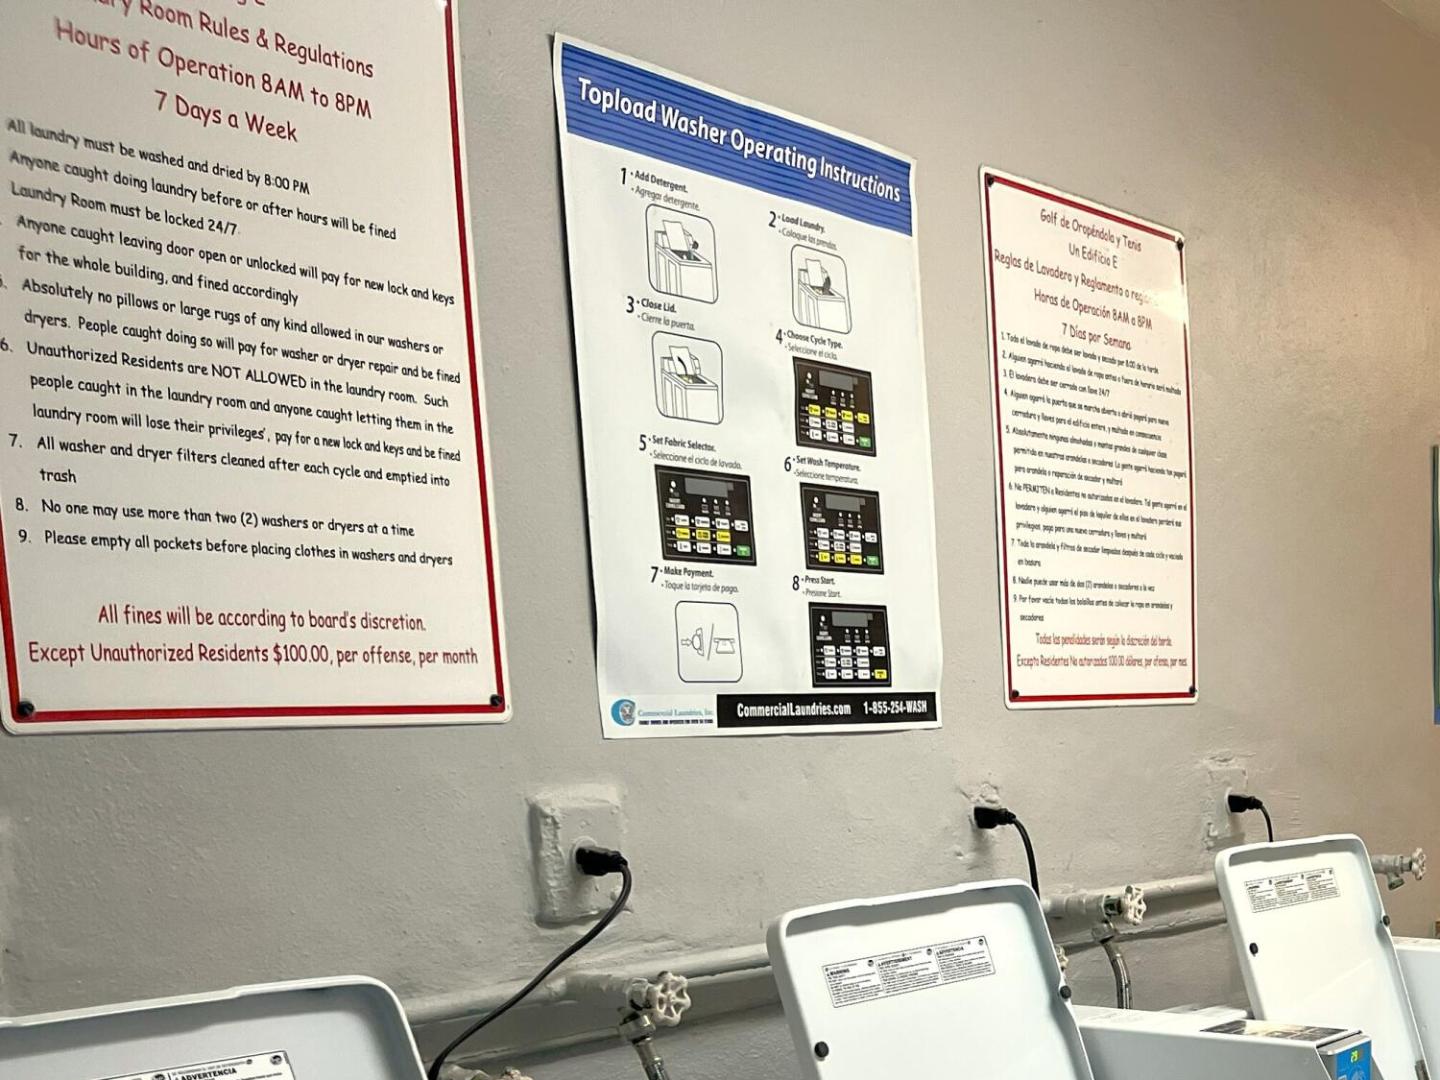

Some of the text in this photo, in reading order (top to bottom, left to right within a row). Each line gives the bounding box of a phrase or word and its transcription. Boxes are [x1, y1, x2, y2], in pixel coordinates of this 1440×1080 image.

[140, 0, 193, 30] Room
[199, 10, 249, 44] Rules
[256, 27, 269, 50] &
[274, 32, 373, 78] Regulations
[54, 16, 372, 120] Hours of Operation 8AM to 8PM
[154, 89, 298, 143] 7 Days a Week
[578, 76, 901, 202] Topload Washer Operating Instructions
[620, 167, 688, 193] 1 Add Detergent.
[768, 211, 776, 228] 2
[1041, 209, 1057, 223] Golf
[1061, 216, 1069, 228] de
[1122, 235, 1141, 251] Tenis
[1069, 243, 1118, 269] Un Edificio E
[994, 249, 1022, 269] Reglas
[1024, 257, 1034, 271] de
[1036, 260, 1072, 282] Lavadero
[1081, 273, 1123, 296] Reglamento
[626, 296, 677, 313] 3 Close Lid.
[1034, 288, 1058, 306] Horas
[1061, 296, 1070, 309] de
[1112, 309, 1130, 325] 8AM
[775, 329, 783, 345] 4
[1062, 322, 1067, 335] 7
[1089, 332, 1101, 344] por
[1104, 333, 1131, 350] Semana
[26, 340, 118, 365] Unauthorized
[121, 352, 184, 373] Residents
[187, 364, 209, 376] are
[211, 363, 242, 380] NOT
[245, 369, 307, 389] ALLOWED
[310, 377, 321, 391] in
[323, 379, 343, 393] the
[346, 381, 386, 403] laundry
[424, 393, 449, 408] Such
[639, 434, 647, 451] 5
[784, 456, 792, 472] 6
[15, 497, 415, 537] 8. No one may use more than two (2) washers or dryers at a time
[650, 566, 659, 583] 7
[792, 575, 800, 591] 8
[98, 603, 118, 624] All
[123, 604, 162, 625] fines
[166, 605, 190, 625] will
[195, 606, 214, 625] be
[218, 608, 286, 633] according
[290, 610, 305, 628] to
[28, 641, 85, 668] Except
[90, 641, 194, 662] Unauthorized
[198, 643, 269, 662] Residents
[336, 649, 358, 668] per
[418, 651, 439, 669] per
[442, 647, 479, 664] month
[737, 700, 927, 718] CommercialLaundries.com 1-855-254-WASH
